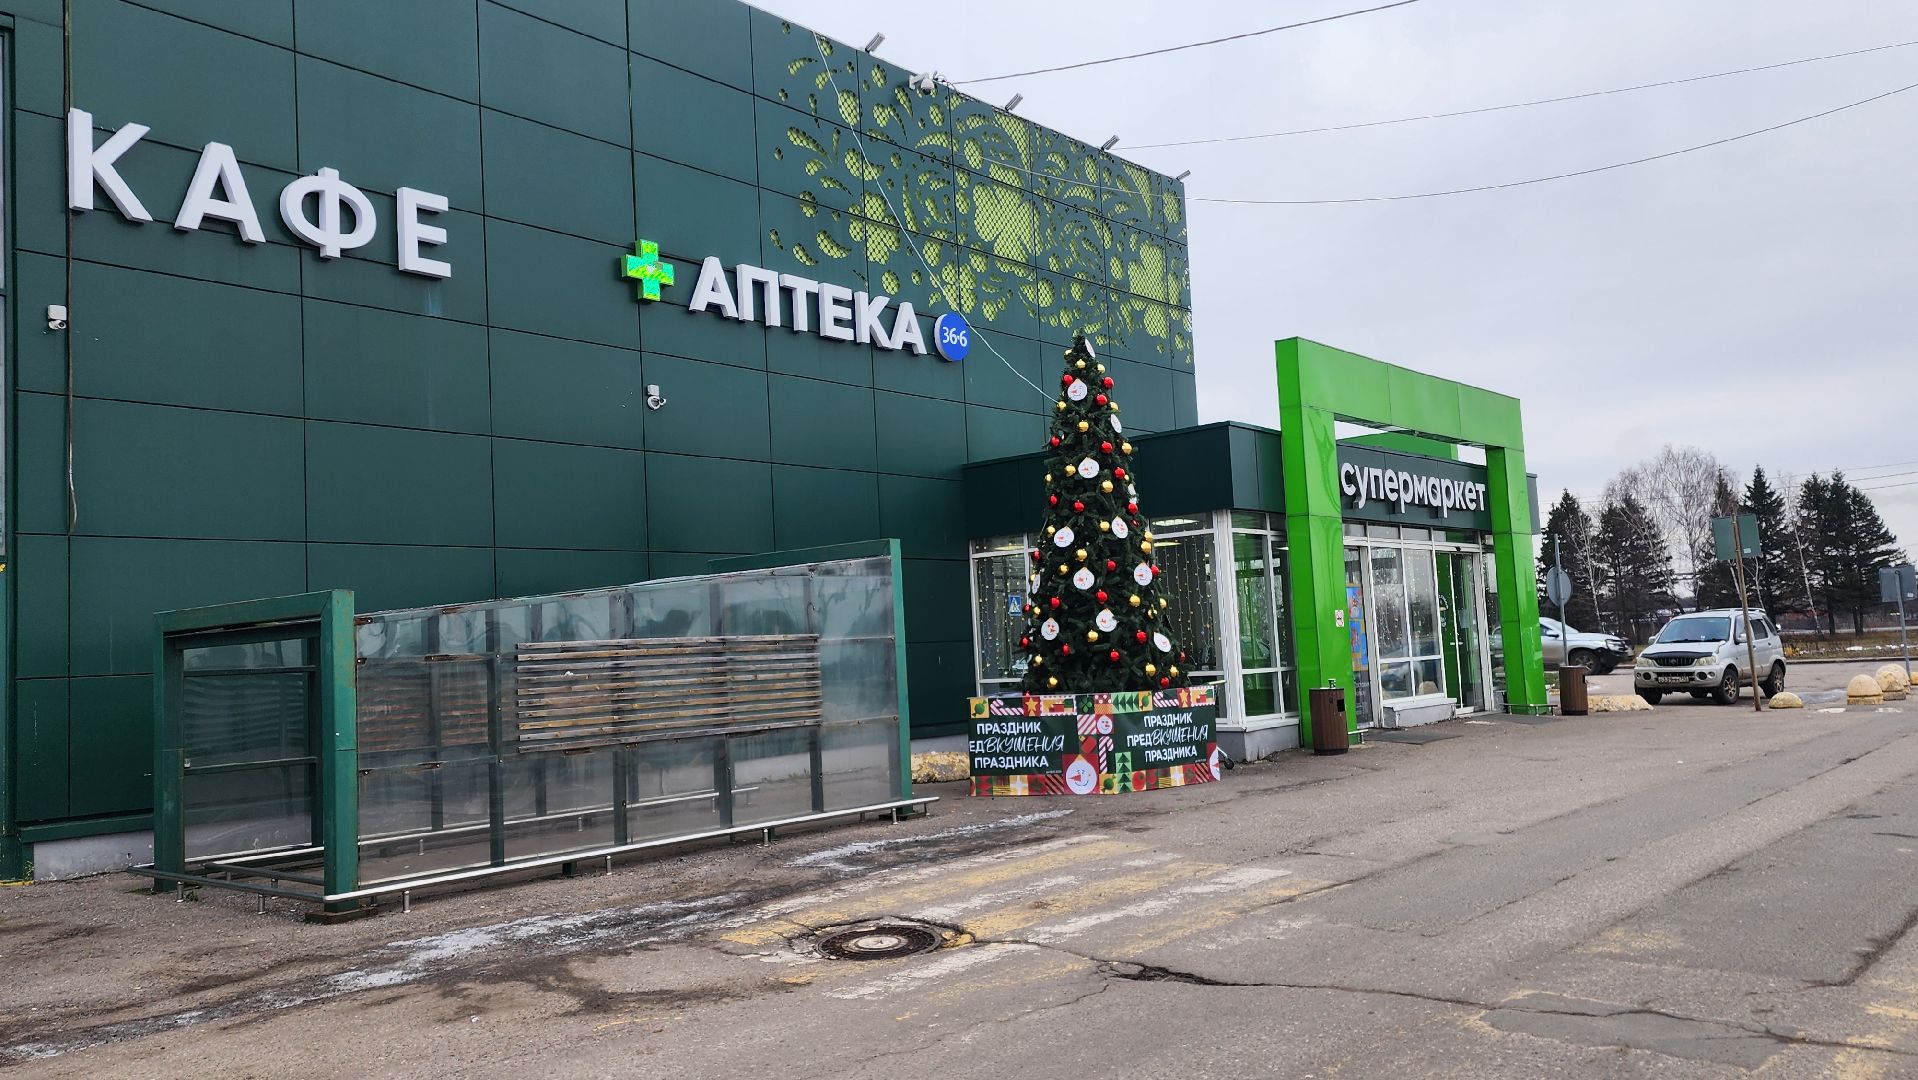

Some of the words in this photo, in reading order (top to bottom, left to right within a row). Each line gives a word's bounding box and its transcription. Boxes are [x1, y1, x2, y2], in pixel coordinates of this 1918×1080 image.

[67, 106, 452, 279] КАФЕ
[688, 255, 928, 355] АПТЕКА
[1340, 462, 1486, 518] супермаркет
[976, 721, 1042, 736] ПРАЗДНИК
[1143, 712, 1193, 728] ПРАЗДНИК
[969, 734, 1065, 754] ЕДВКУШЕНИЯ
[974, 755, 1050, 770] ПРАЗДНИКА
[1144, 745, 1198, 763] ПРАЗДНИКА
